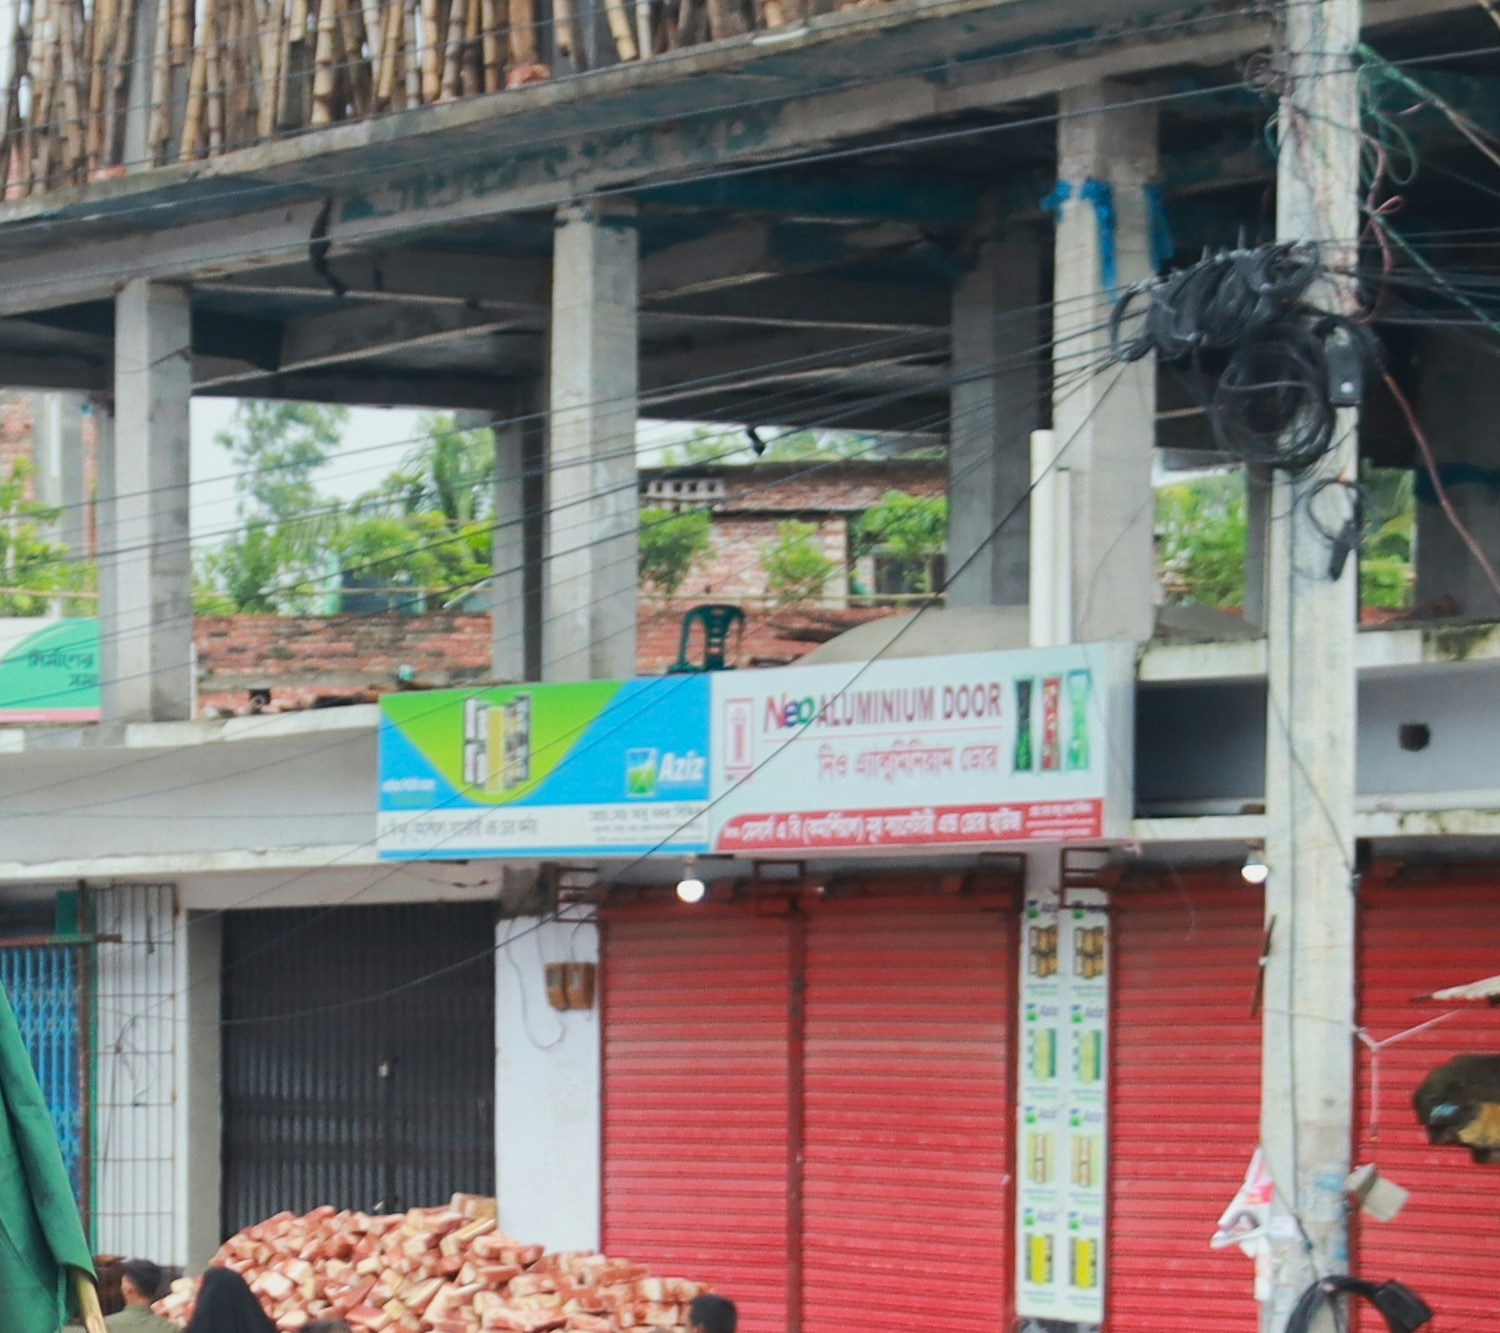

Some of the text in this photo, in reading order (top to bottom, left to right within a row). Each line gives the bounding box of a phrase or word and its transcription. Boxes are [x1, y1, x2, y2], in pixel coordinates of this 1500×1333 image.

[762, 681, 1002, 733] Neo ALUMINIUM DOOR
[658, 750, 706, 782] Aziz
